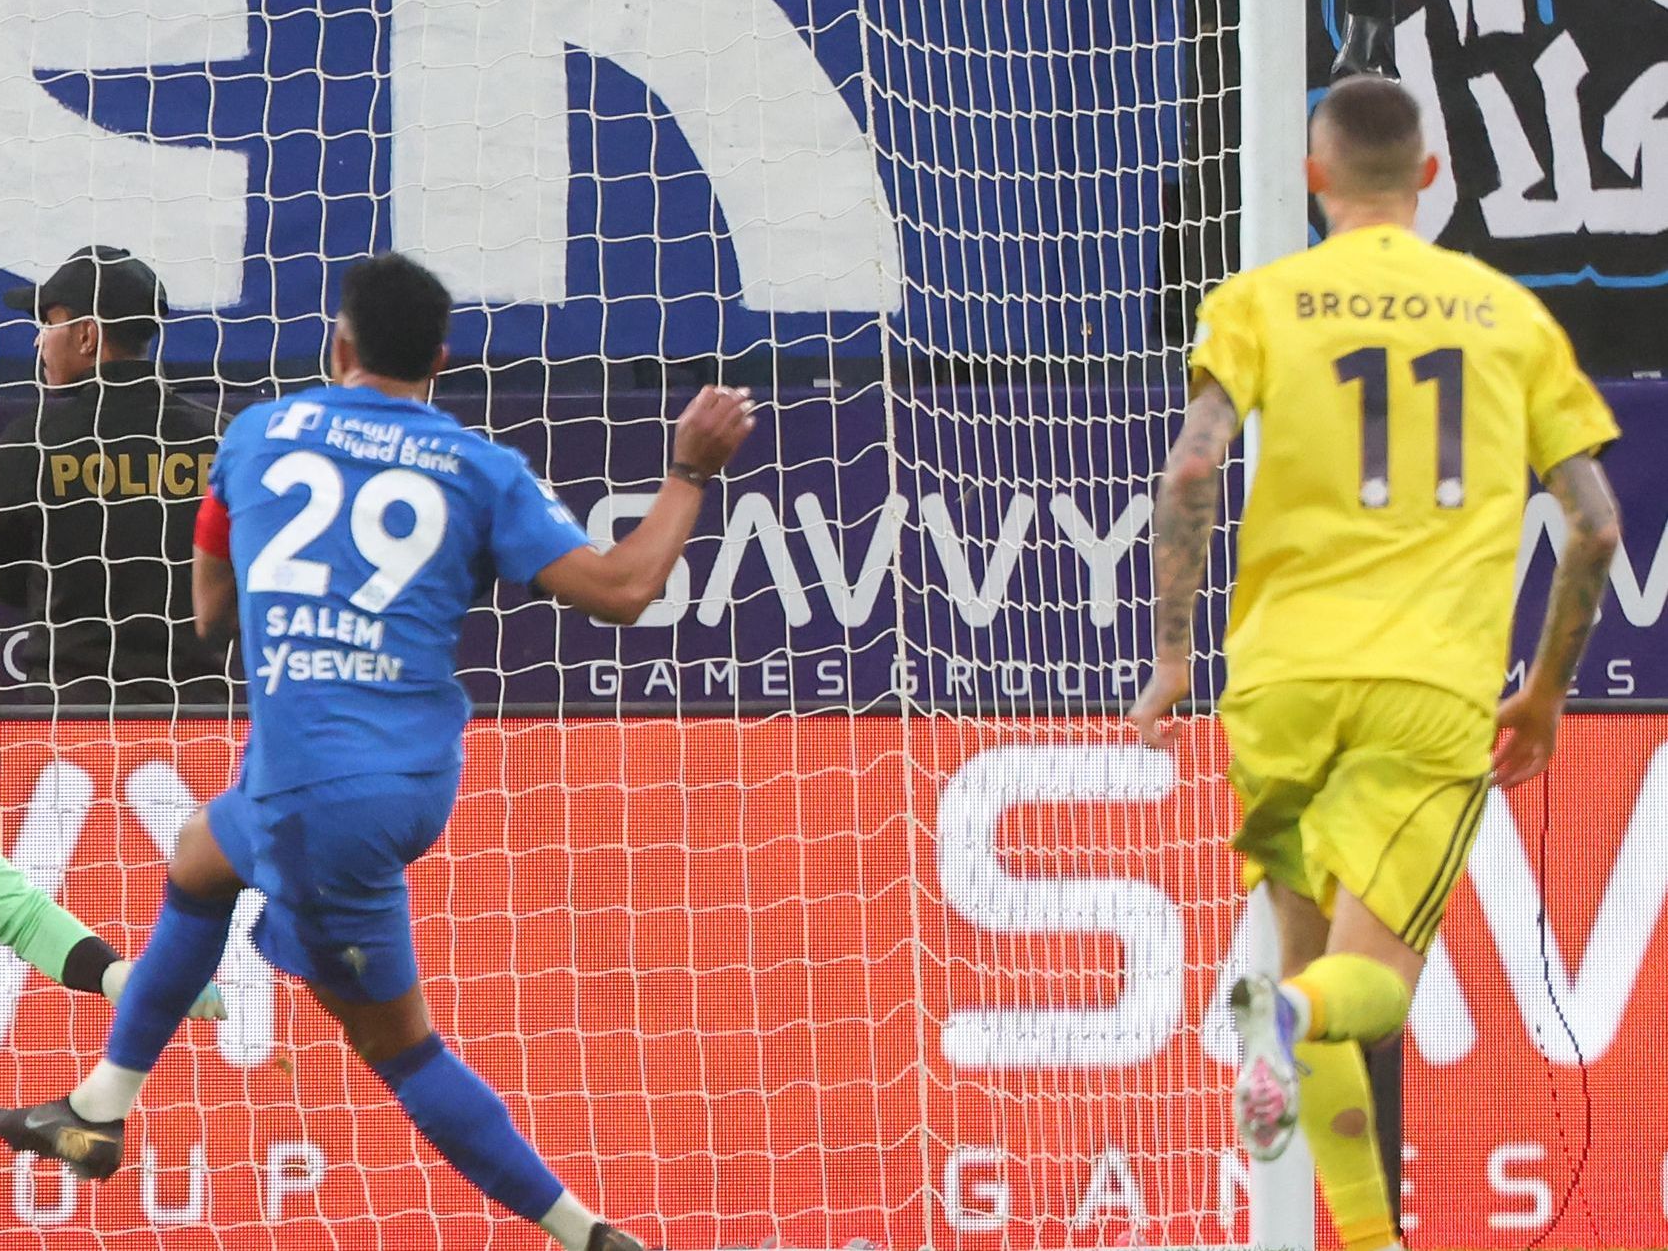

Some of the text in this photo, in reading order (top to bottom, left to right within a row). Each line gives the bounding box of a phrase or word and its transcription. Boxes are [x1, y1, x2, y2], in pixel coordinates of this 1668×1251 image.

[1295, 293, 1496, 329] BROZOVIĆ
[1332, 346, 1464, 509] 11
[246, 451, 448, 615] 29
[265, 604, 385, 650] SALEM
[589, 659, 1140, 697] GAMES GROUP
